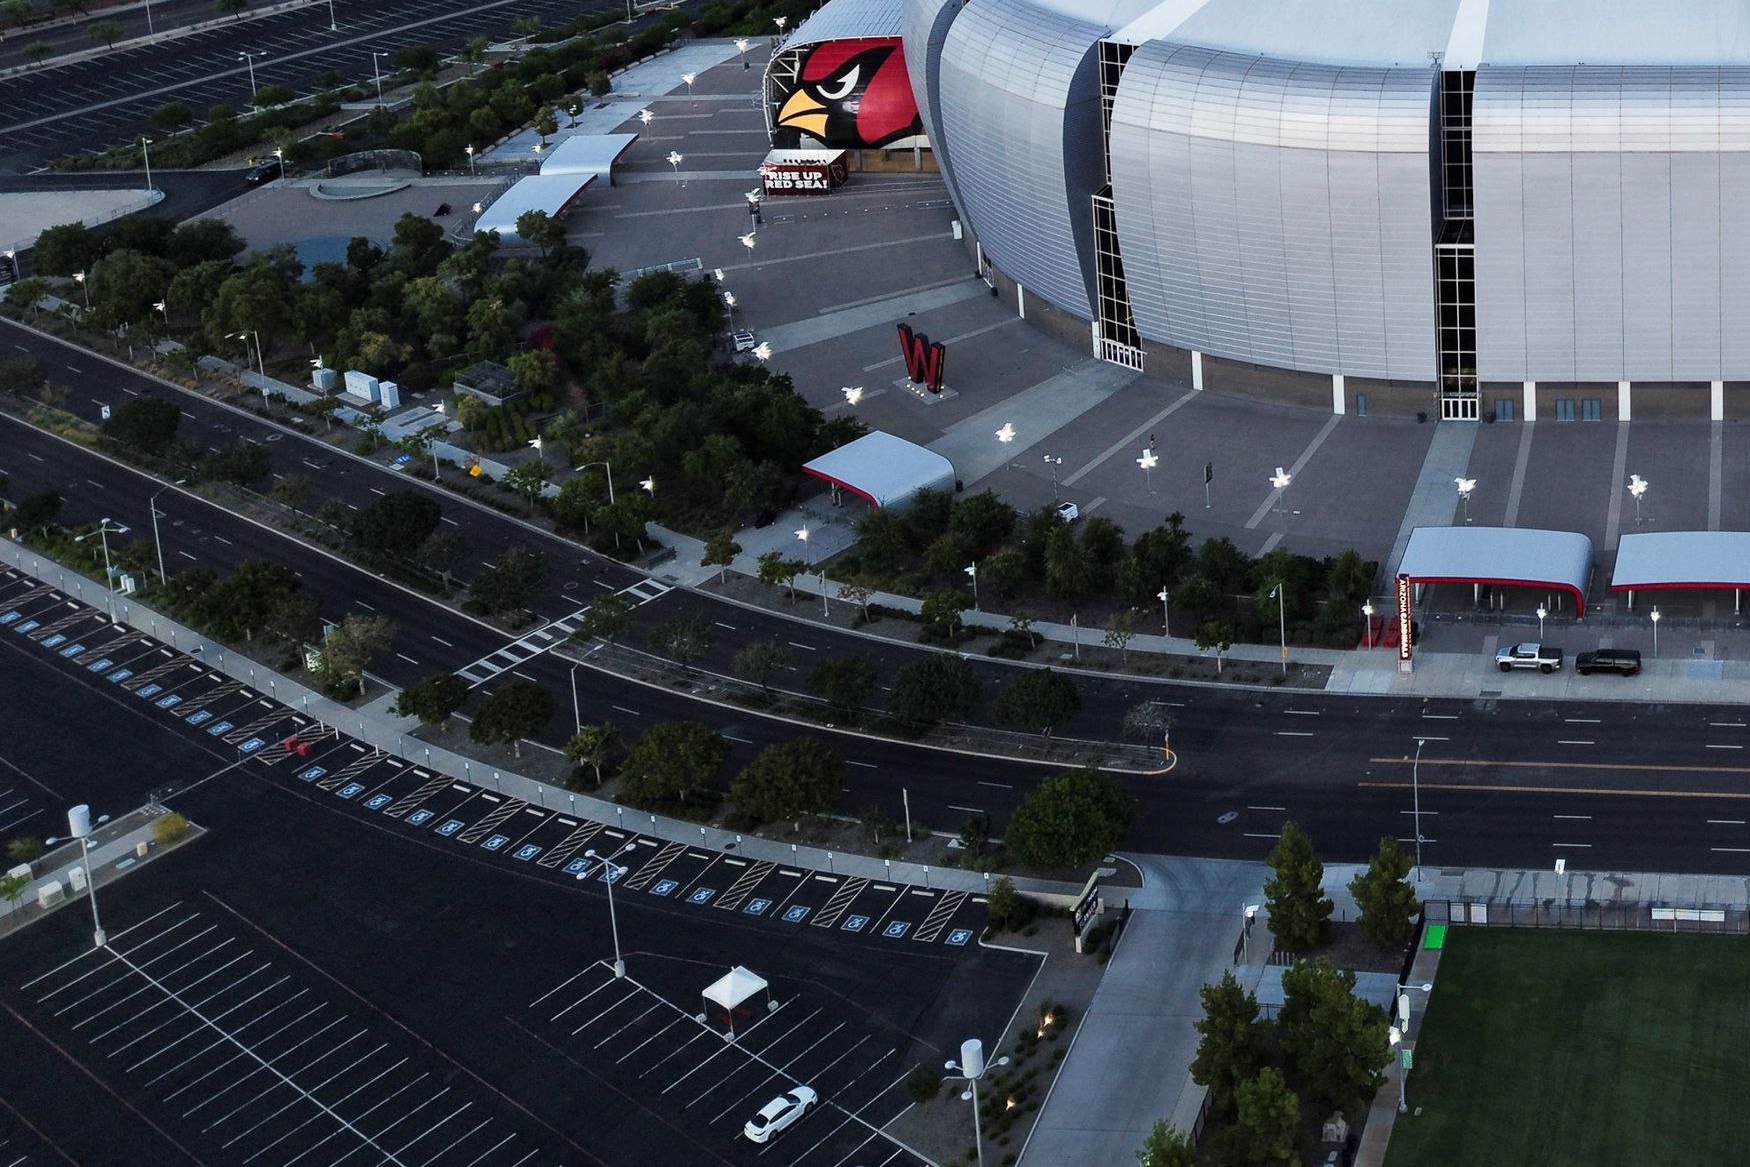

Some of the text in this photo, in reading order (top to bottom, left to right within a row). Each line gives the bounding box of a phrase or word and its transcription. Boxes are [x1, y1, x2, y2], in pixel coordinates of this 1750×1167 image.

[766, 171, 822, 180] RISE UP
[764, 180, 828, 189] RED SEA!
[897, 323, 945, 394] W
